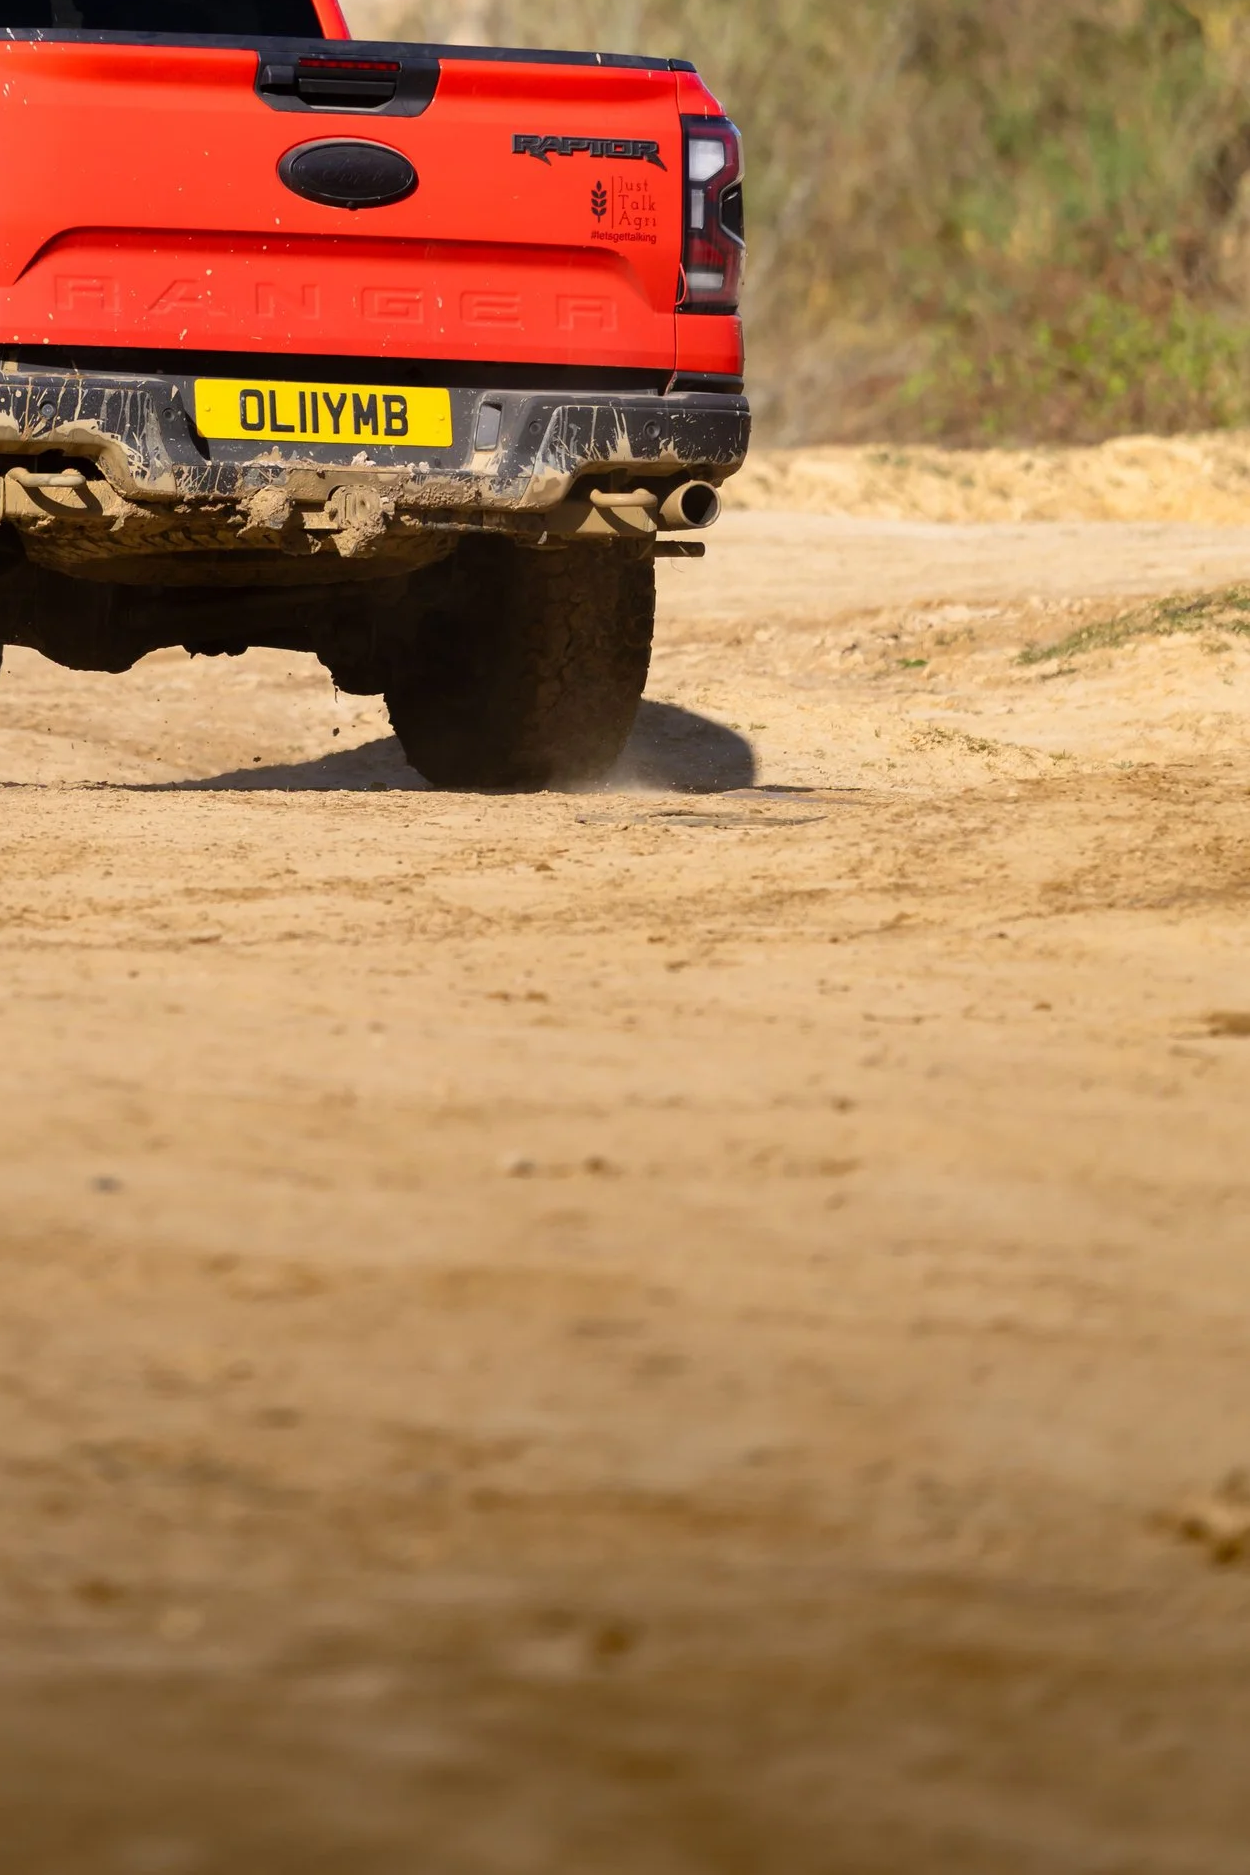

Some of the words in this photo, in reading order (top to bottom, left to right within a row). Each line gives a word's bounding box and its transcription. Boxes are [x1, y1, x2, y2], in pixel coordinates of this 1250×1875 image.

[511, 134, 667, 171] RAPTOR
[618, 175, 648, 193] Just
[618, 194, 656, 211] Talk
[618, 210, 657, 231] Agri
[591, 230, 657, 245] #letsgettalking
[53, 274, 618, 332] RANGER
